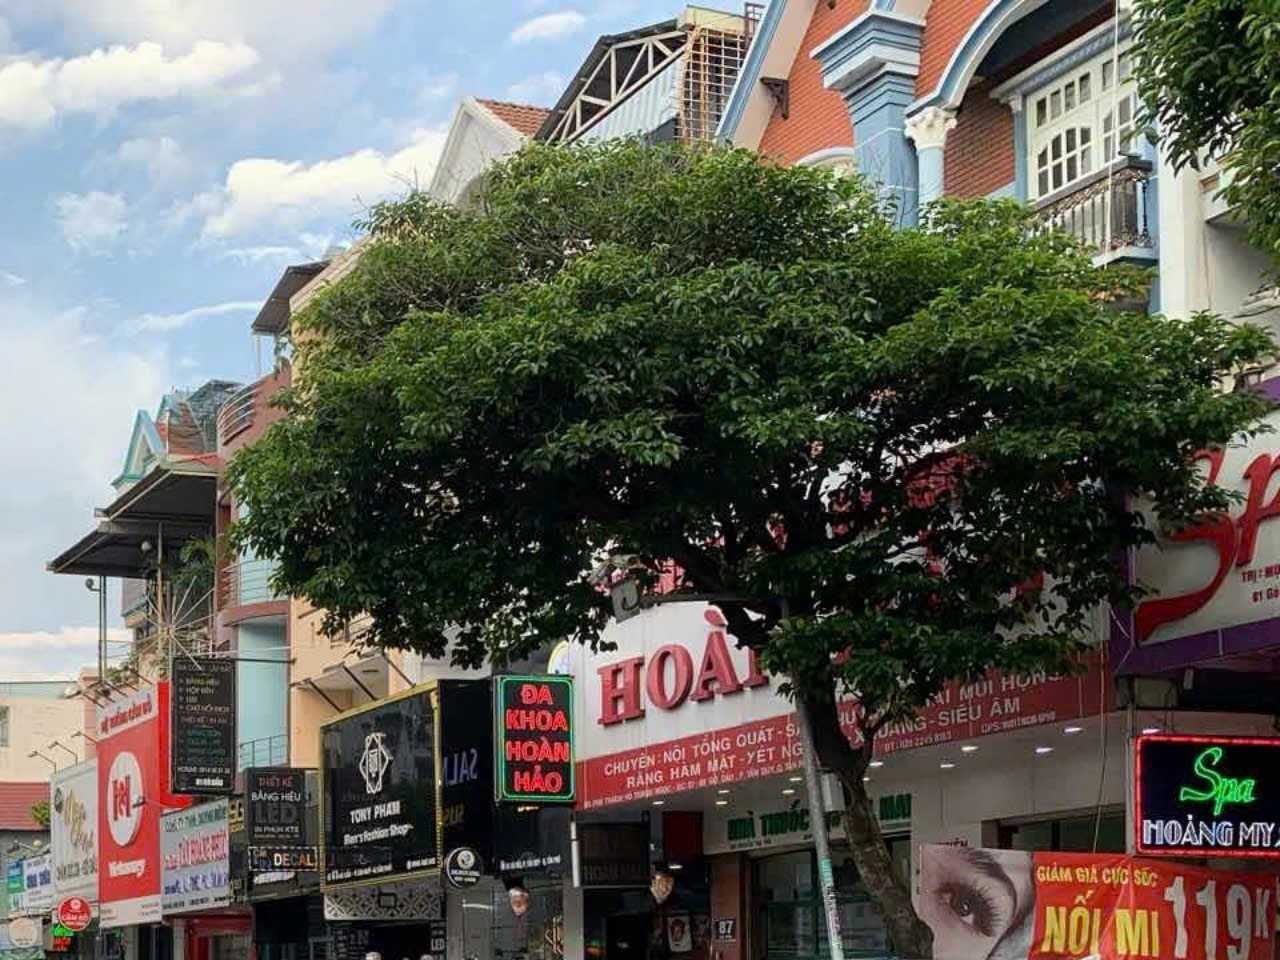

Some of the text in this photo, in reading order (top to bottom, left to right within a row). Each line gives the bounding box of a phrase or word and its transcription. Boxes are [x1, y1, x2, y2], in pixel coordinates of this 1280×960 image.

[521, 684, 554, 705] ĐA
[990, 697, 1020, 716] ÂM
[506, 708, 569, 731] KHOA
[505, 736, 570, 762] HOÀN
[604, 749, 656, 778] CHUYÊN
[663, 746, 686, 766] NỘI
[693, 733, 732, 758] TỔNG
[736, 725, 775, 748] QUÁT
[513, 764, 563, 793] HẢO
[671, 759, 701, 781] HÀM
[1180, 746, 1255, 816] Spa
[251, 788, 279, 802] BẢNG
[255, 801, 298, 824] LED
[350, 808, 371, 824] TONY
[274, 853, 314, 867] DECAL
[1037, 862, 1073, 883] GIẢM
[719, 920, 734, 933] 87
[1041, 889, 1160, 958] NỐI MI
